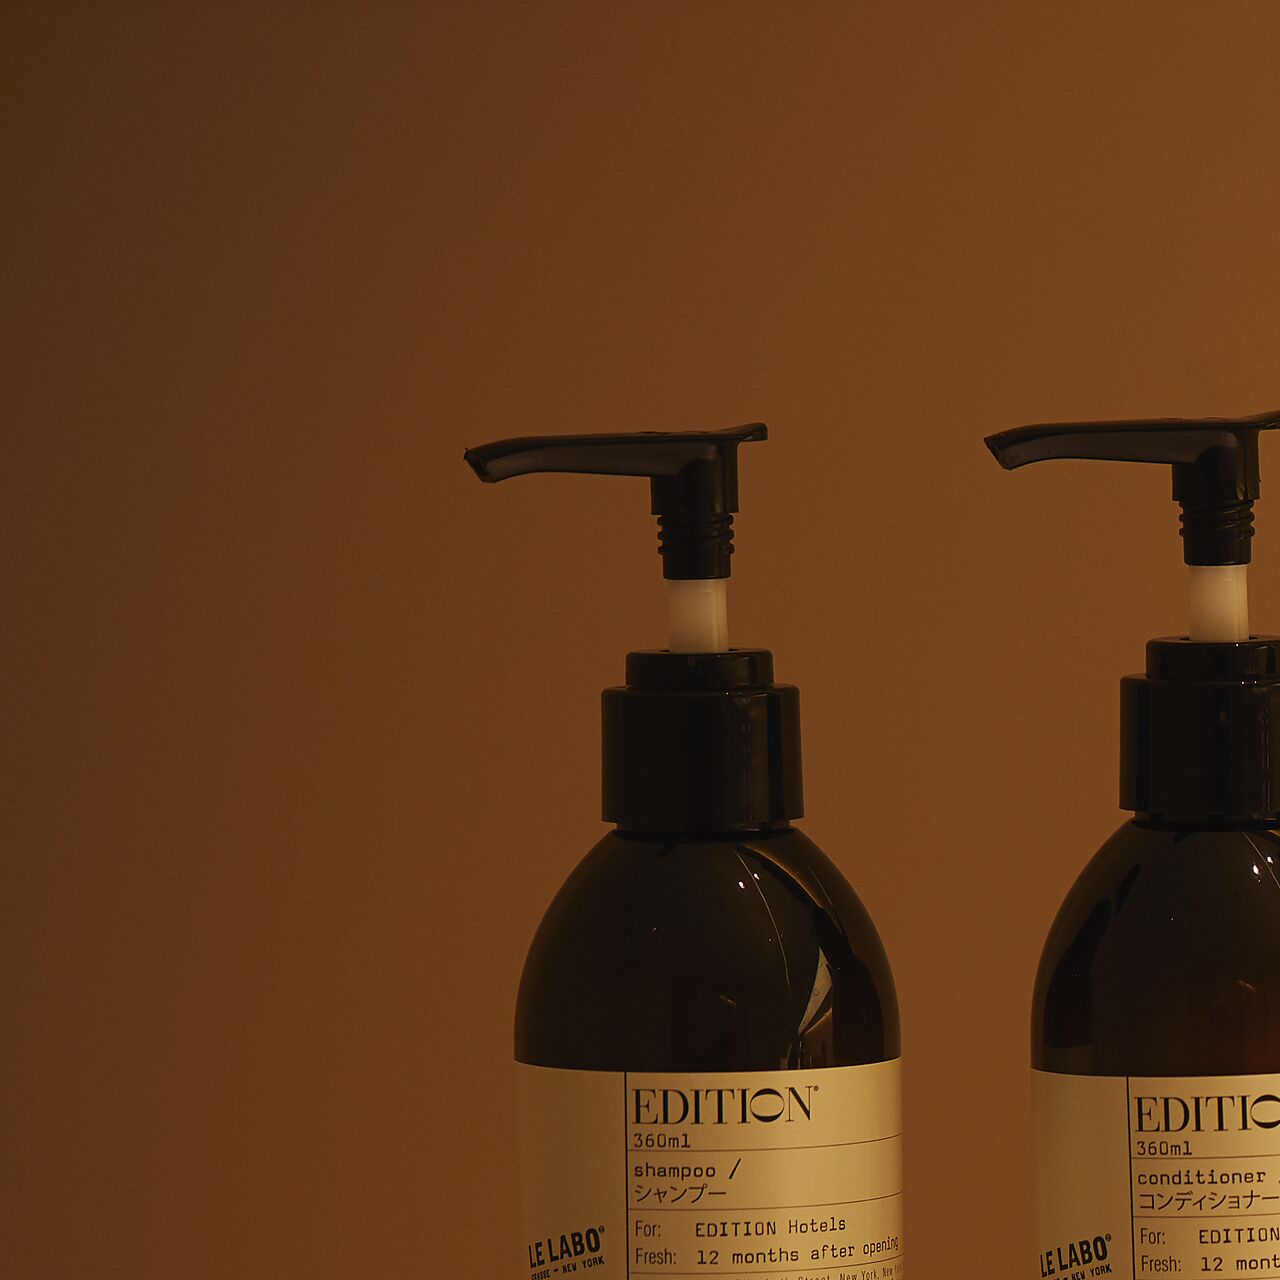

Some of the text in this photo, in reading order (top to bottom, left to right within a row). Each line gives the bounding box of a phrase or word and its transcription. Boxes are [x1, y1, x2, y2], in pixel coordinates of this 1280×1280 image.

[634, 1133, 691, 1148] 360ml
[1137, 1140, 1192, 1156] 360ml
[634, 1162, 716, 1181] shampoo
[1138, 1169, 1266, 1185] conditioner
[634, 1182, 727, 1204] シャンプー
[1139, 1189, 1280, 1211] コンディショナー
[635, 1216, 846, 1237] For: EDITION Hotels
[1140, 1227, 1165, 1245] For:
[1199, 1227, 1280, 1244] EDITION
[528, 1241, 545, 1269] LE
[635, 1236, 898, 1265] Fresh: 12 months after opening
[561, 1262, 579, 1274] NEW
[581, 1253, 605, 1269] YORK
[1040, 1250, 1056, 1278] LE
[1089, 1261, 1112, 1277] YORK
[1141, 1255, 1181, 1272] Fresh:
[1201, 1257, 1223, 1272] 12
